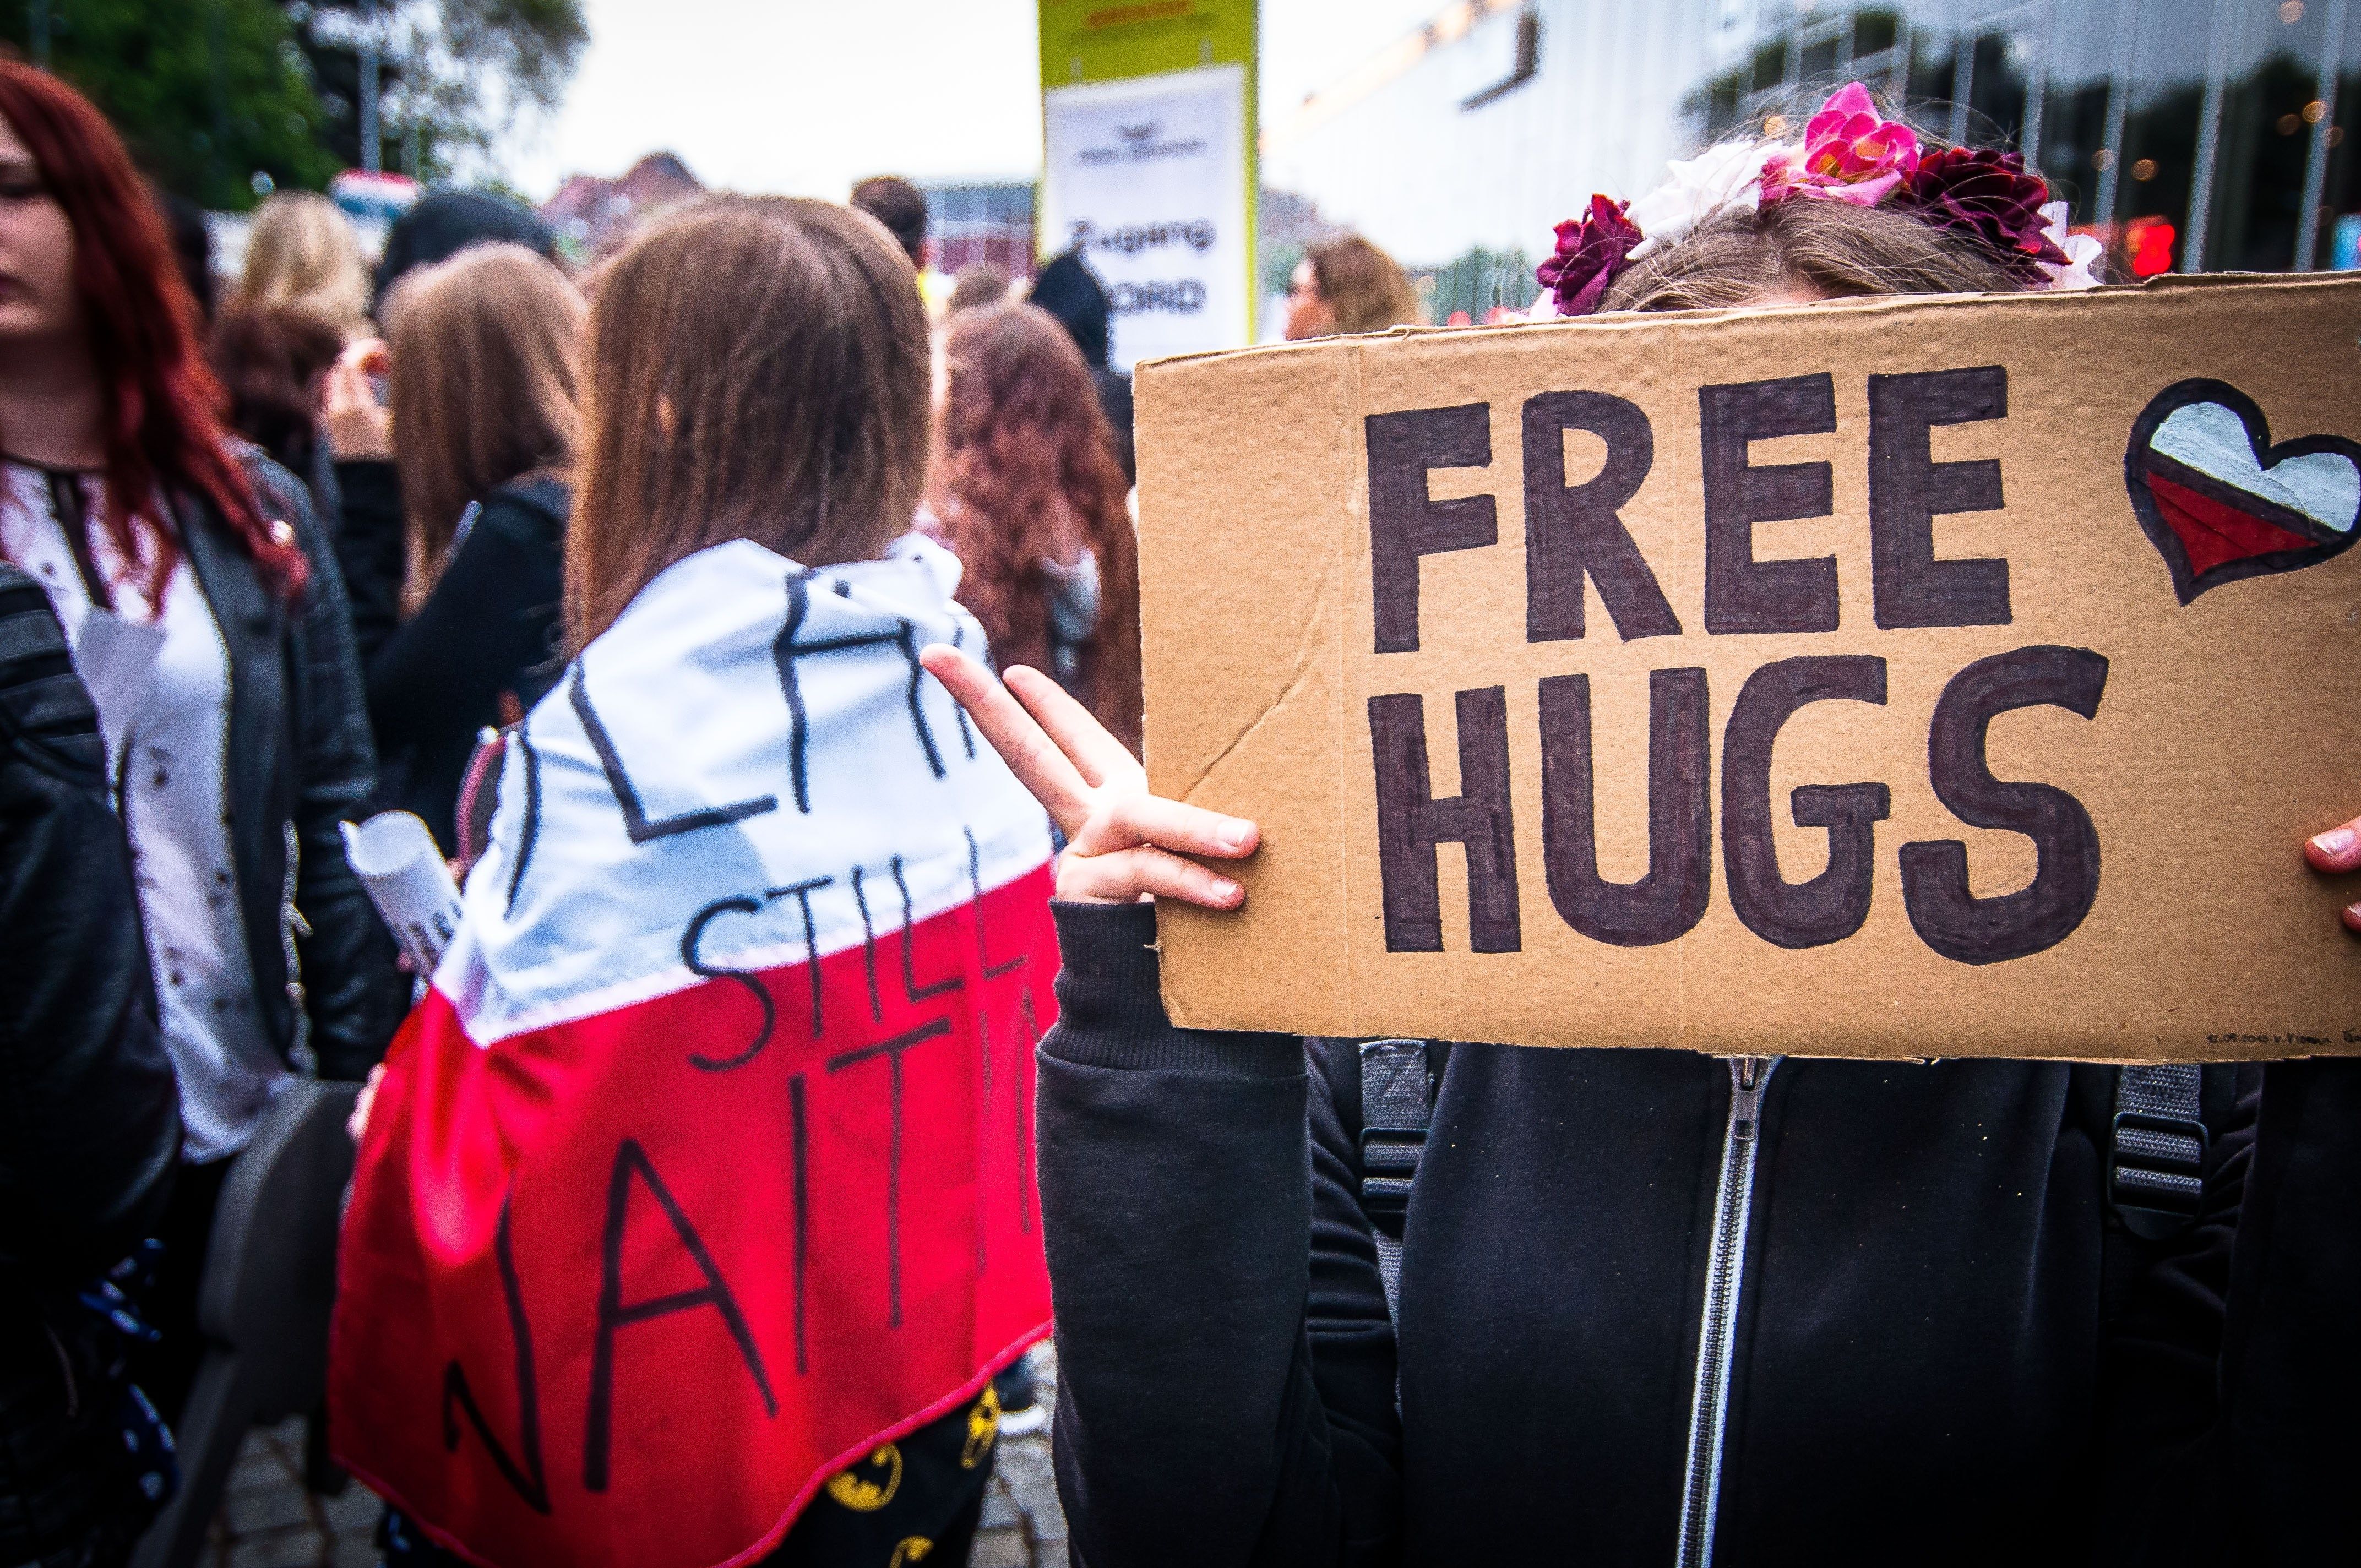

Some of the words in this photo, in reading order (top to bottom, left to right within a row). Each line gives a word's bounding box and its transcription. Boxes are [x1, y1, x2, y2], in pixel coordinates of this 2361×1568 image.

[1108, 280, 1206, 315] ORD
[1365, 365, 2012, 653] FREE
[1367, 645, 2110, 966] HUGS
[681, 825, 1027, 1071] STILL
